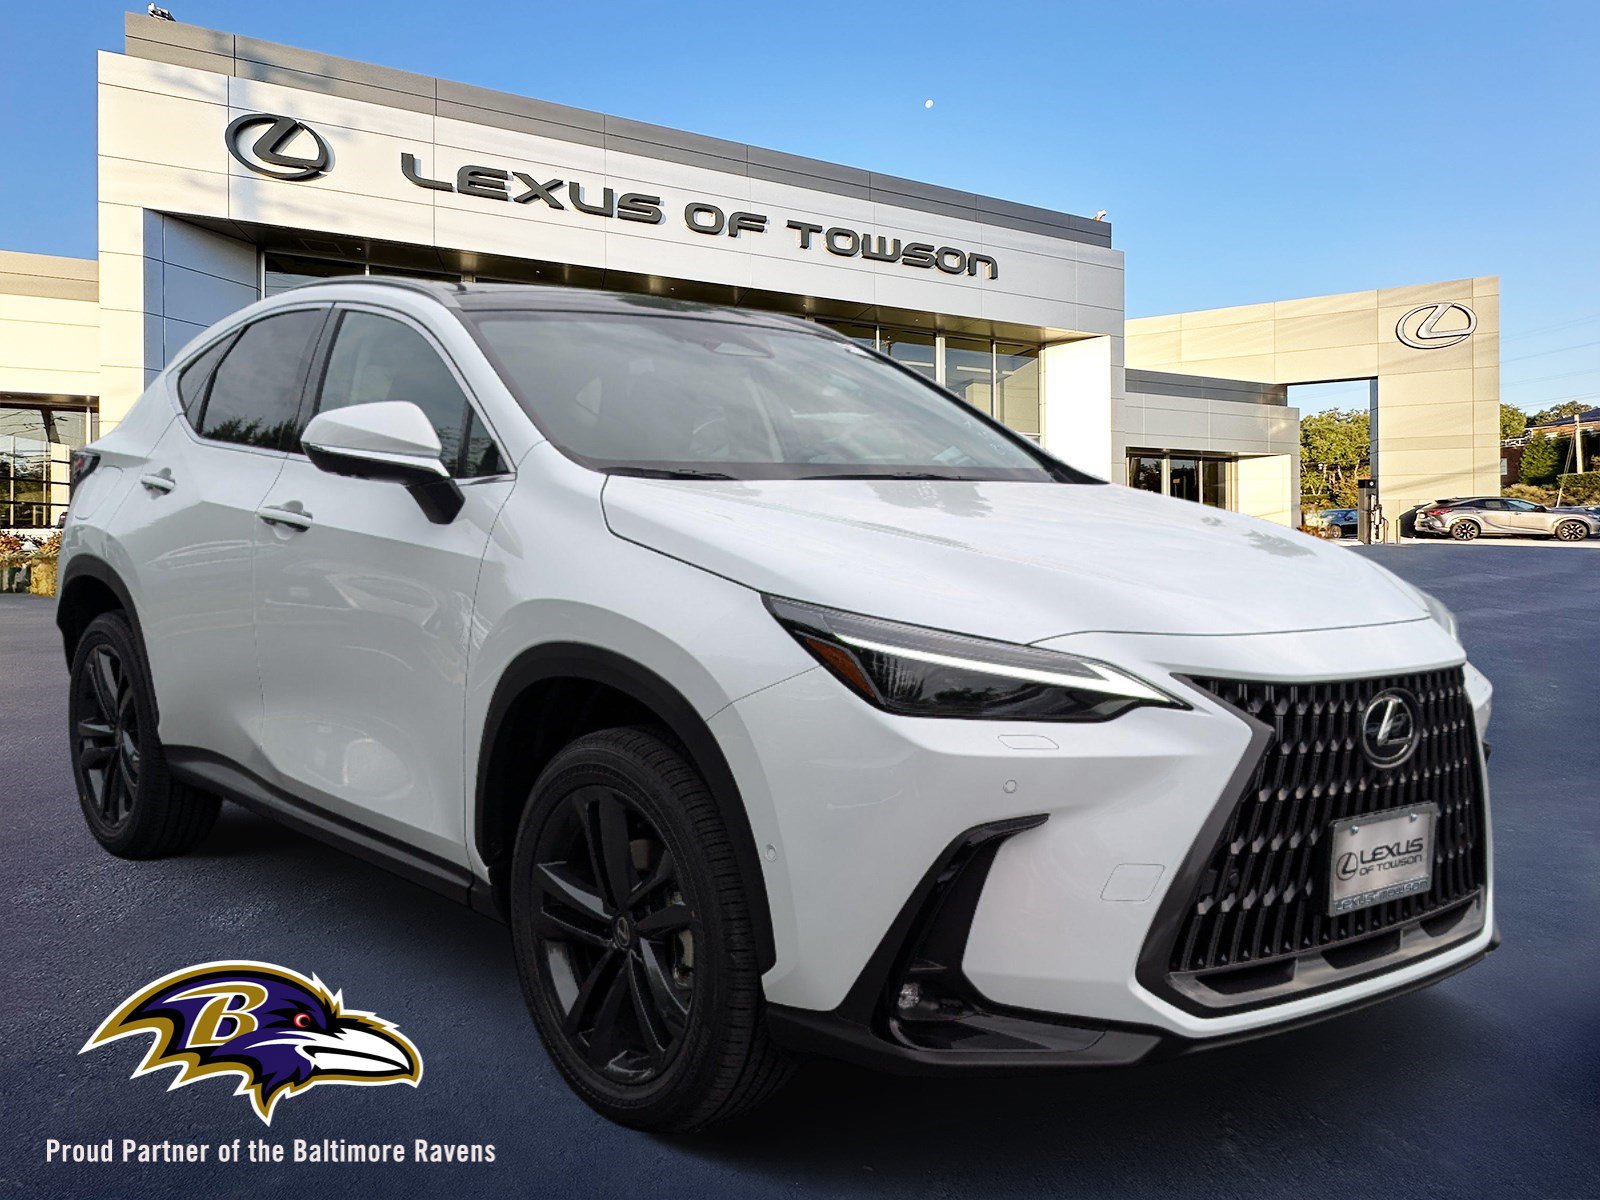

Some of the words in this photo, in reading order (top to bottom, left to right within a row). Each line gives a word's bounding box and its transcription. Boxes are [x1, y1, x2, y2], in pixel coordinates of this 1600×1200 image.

[401, 152, 663, 225] LEXUS
[684, 202, 767, 238] OF
[787, 219, 999, 280] TOWSON
[1360, 837, 1424, 865] LEXUS
[1359, 864, 1375, 877] OF
[1376, 854, 1423, 872] TOWSON
